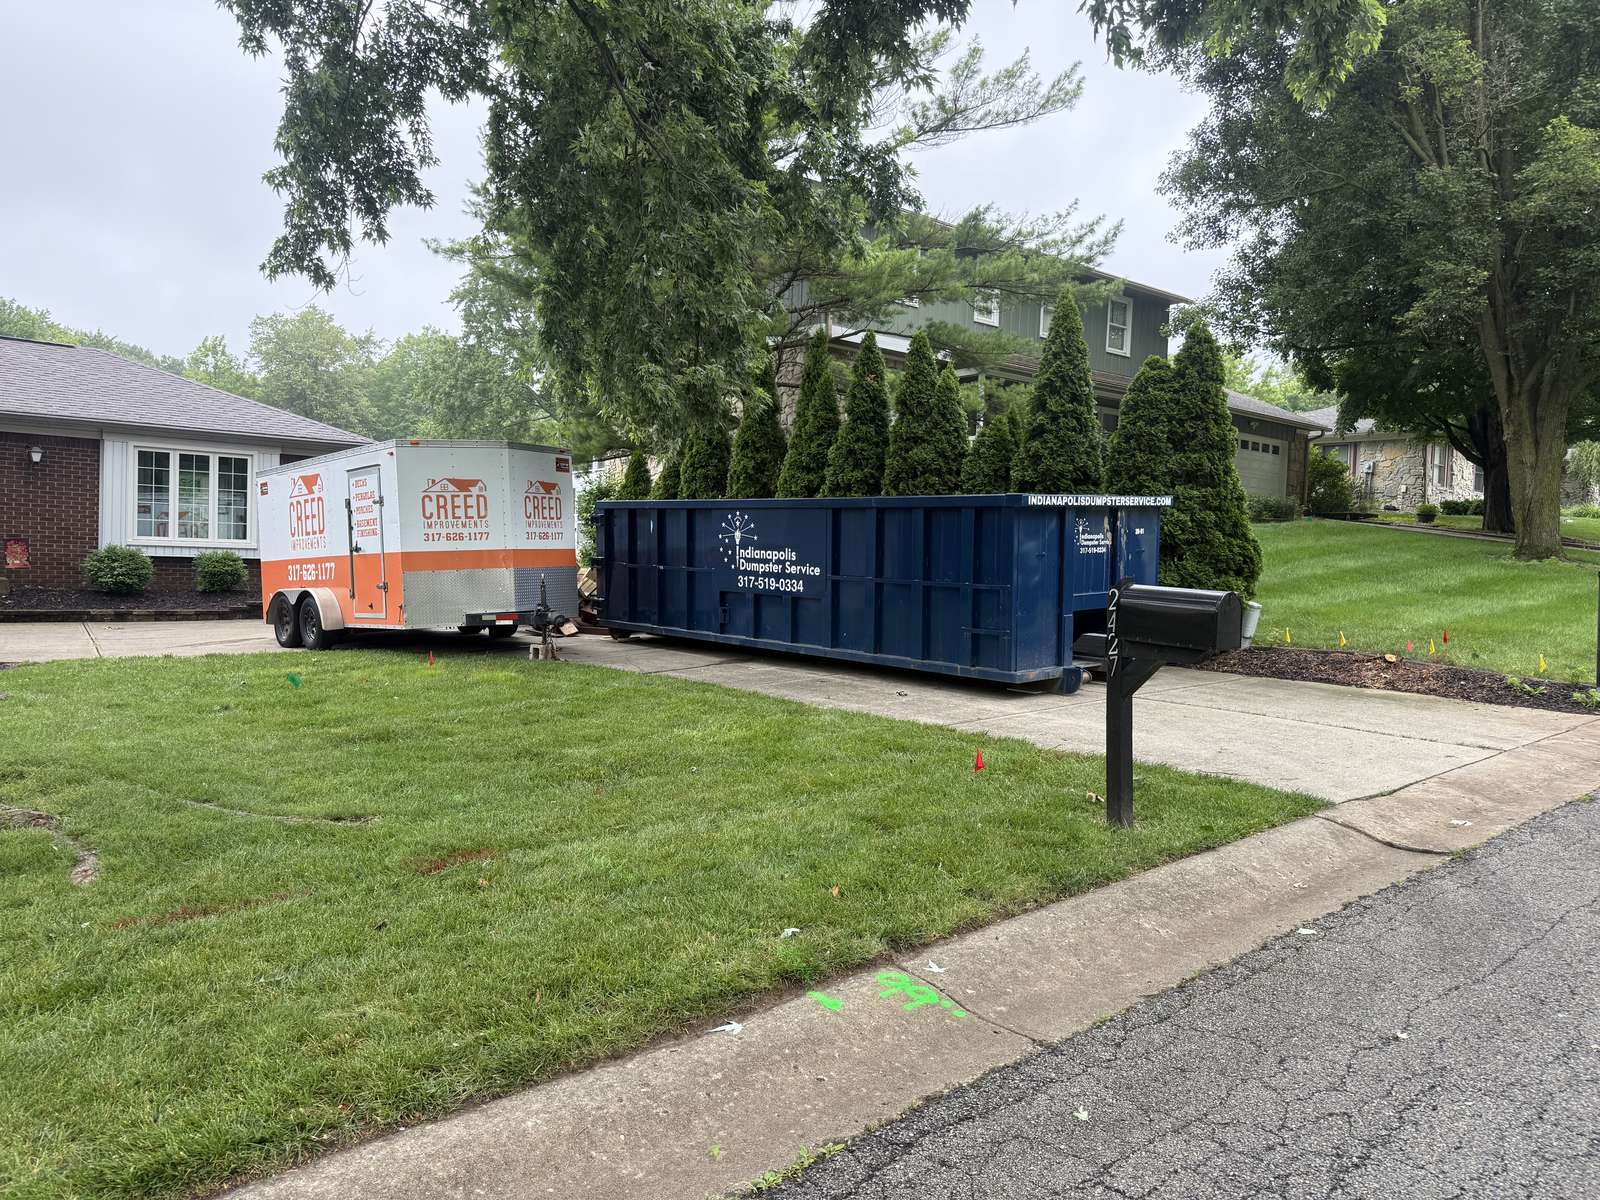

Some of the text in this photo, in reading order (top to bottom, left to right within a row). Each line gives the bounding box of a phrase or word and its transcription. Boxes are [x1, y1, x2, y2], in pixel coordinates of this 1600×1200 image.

[421, 494, 488, 520] CREED
[524, 495, 562, 520] CREED
[1028, 495, 1172, 506] INDIANAPOLISDUMPSTERSERVICE.COM
[289, 496, 325, 538] CREED
[423, 520, 489, 529] IMPROVEMENTS
[525, 520, 563, 529] IMPROVEMENTS
[291, 536, 327, 551] IMPROVEMENTS
[423, 532, 490, 542] 317-626-1177
[526, 531, 564, 541] 317-626-1177
[736, 546, 797, 562] Indianapolis
[288, 562, 336, 581] 317-626-1177
[739, 559, 821, 576] Dumpster Service
[737, 575, 804, 593] 317-519-0334
[1107, 588, 1119, 677] 2427
